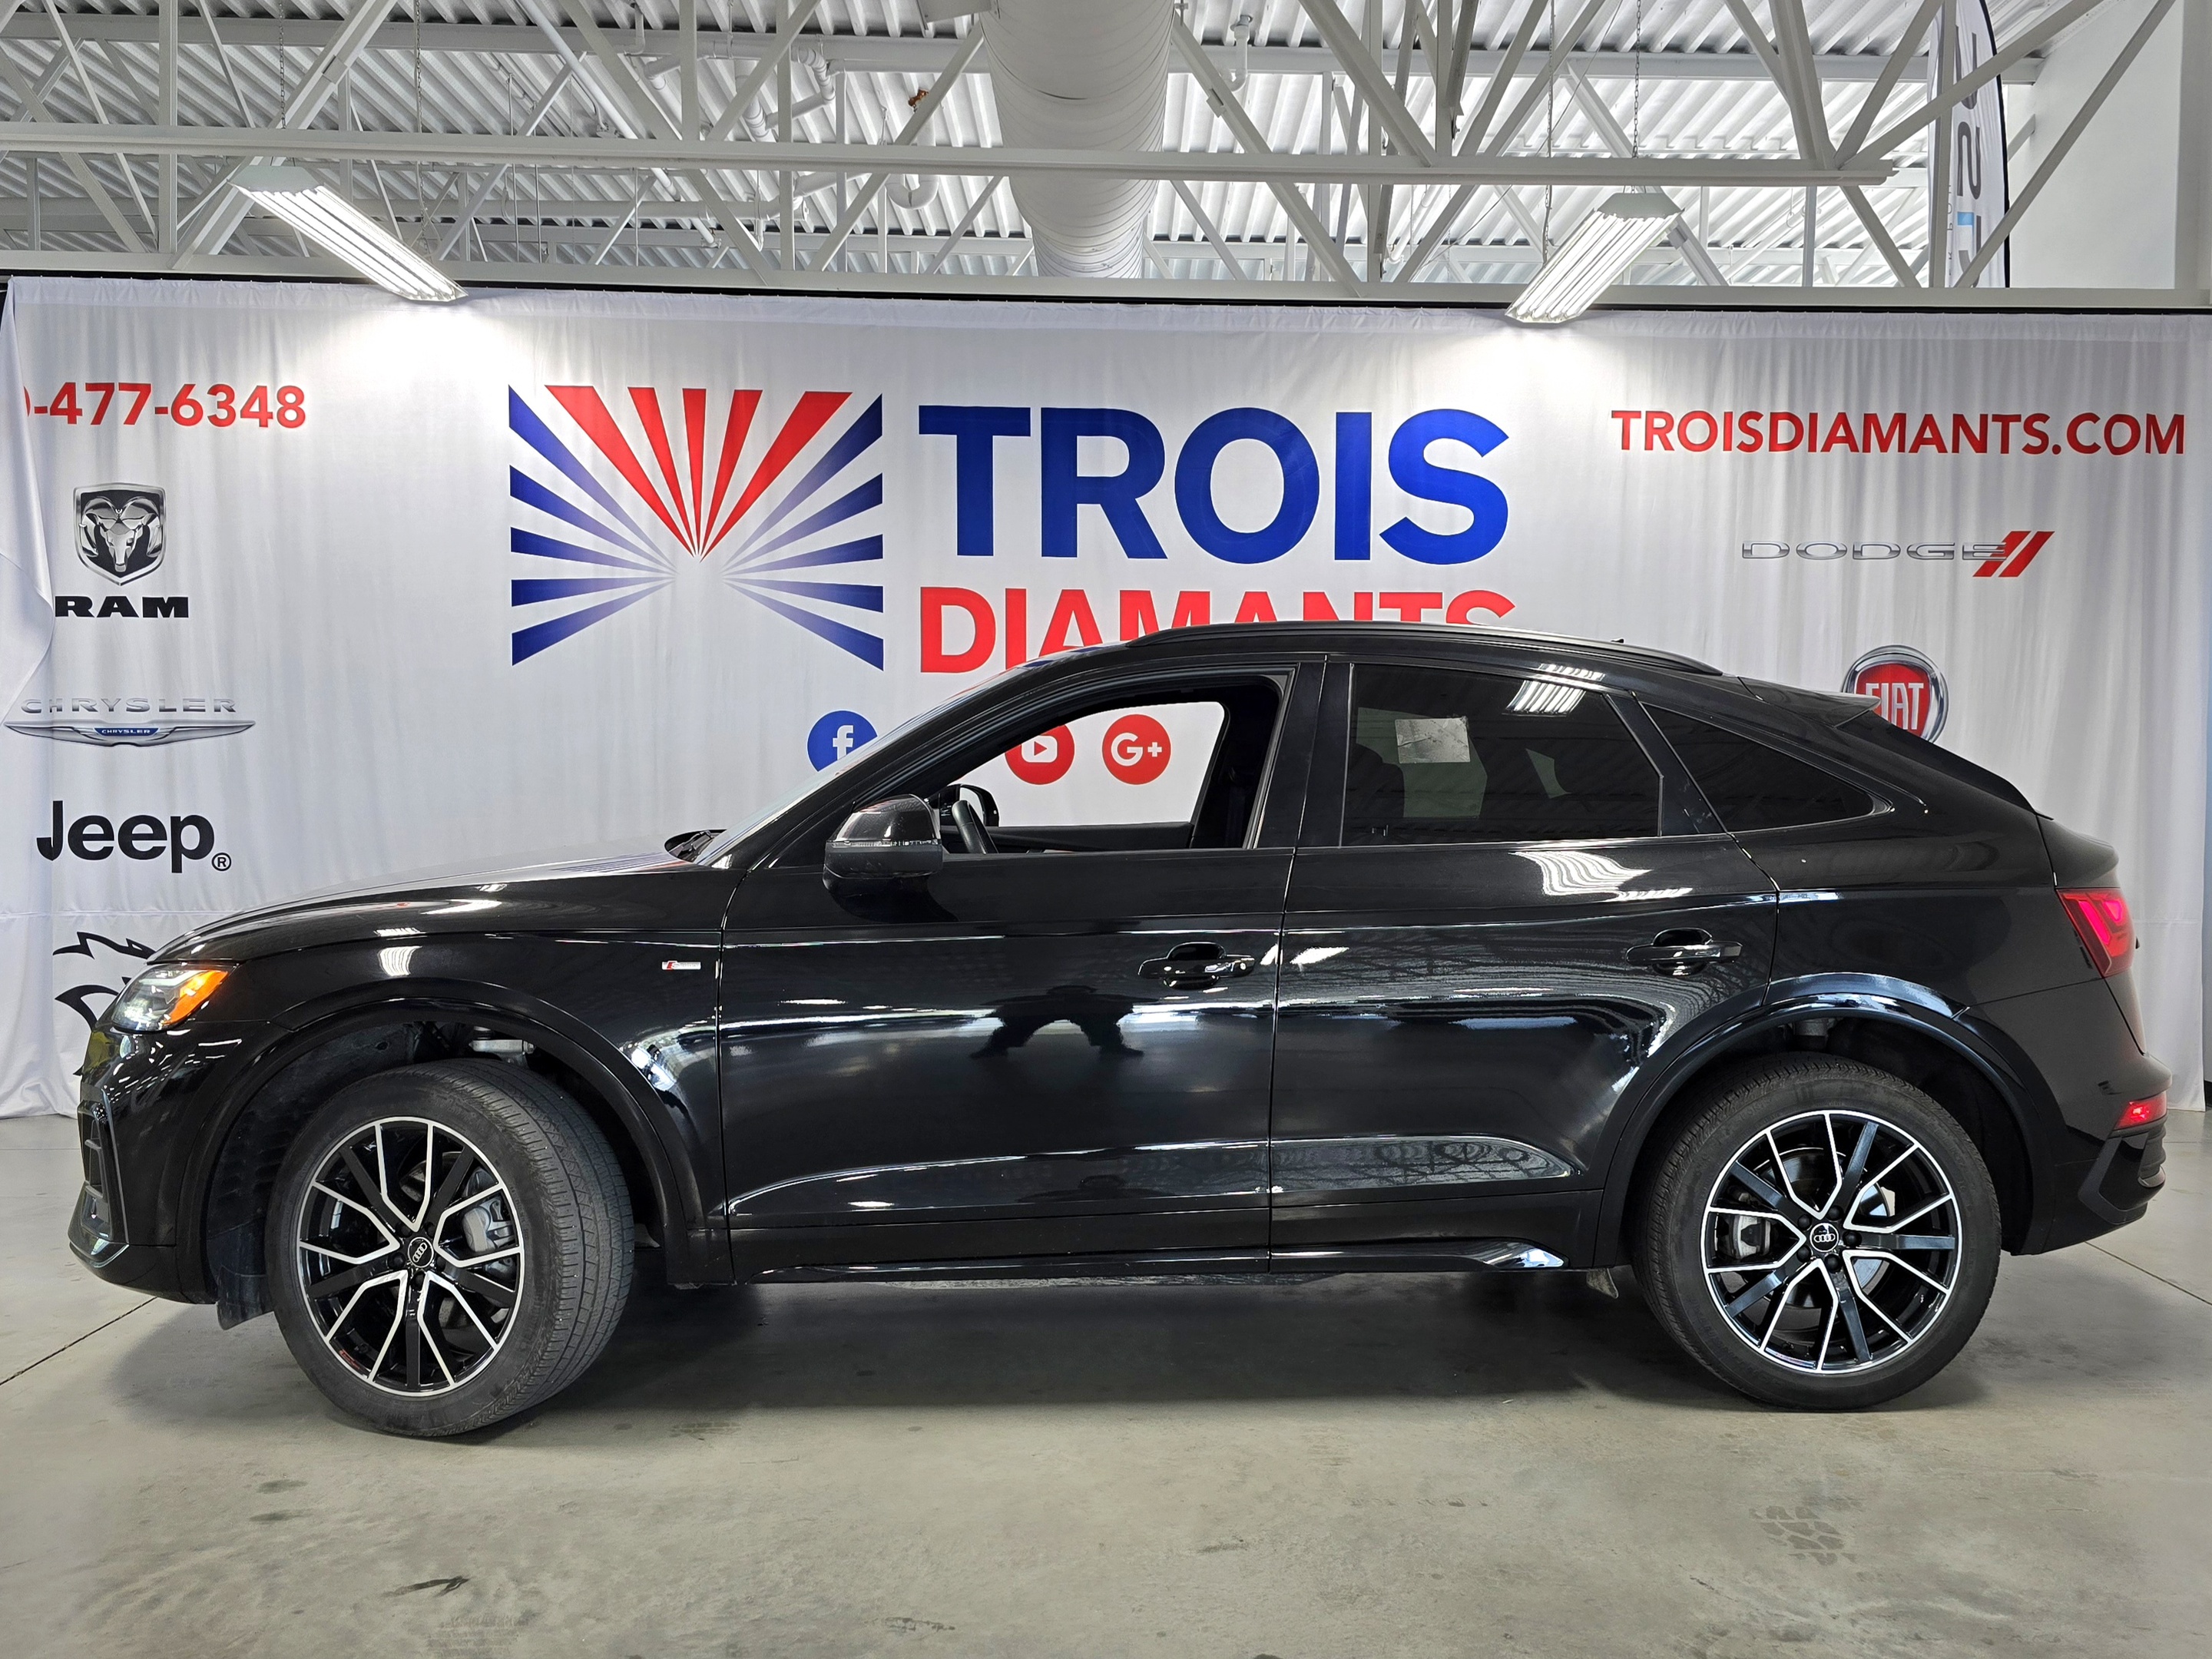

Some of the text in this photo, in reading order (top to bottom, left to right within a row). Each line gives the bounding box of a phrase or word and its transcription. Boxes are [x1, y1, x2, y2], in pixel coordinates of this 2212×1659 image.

[24, 382, 306, 429] -477-6348
[1611, 410, 2186, 455] TROISDIAMANTS.COM
[919, 406, 1509, 565] TROIS
[1742, 542, 2007, 561] DODGE
[55, 596, 189, 618] RAM
[21, 697, 237, 714] CHRYSLER
